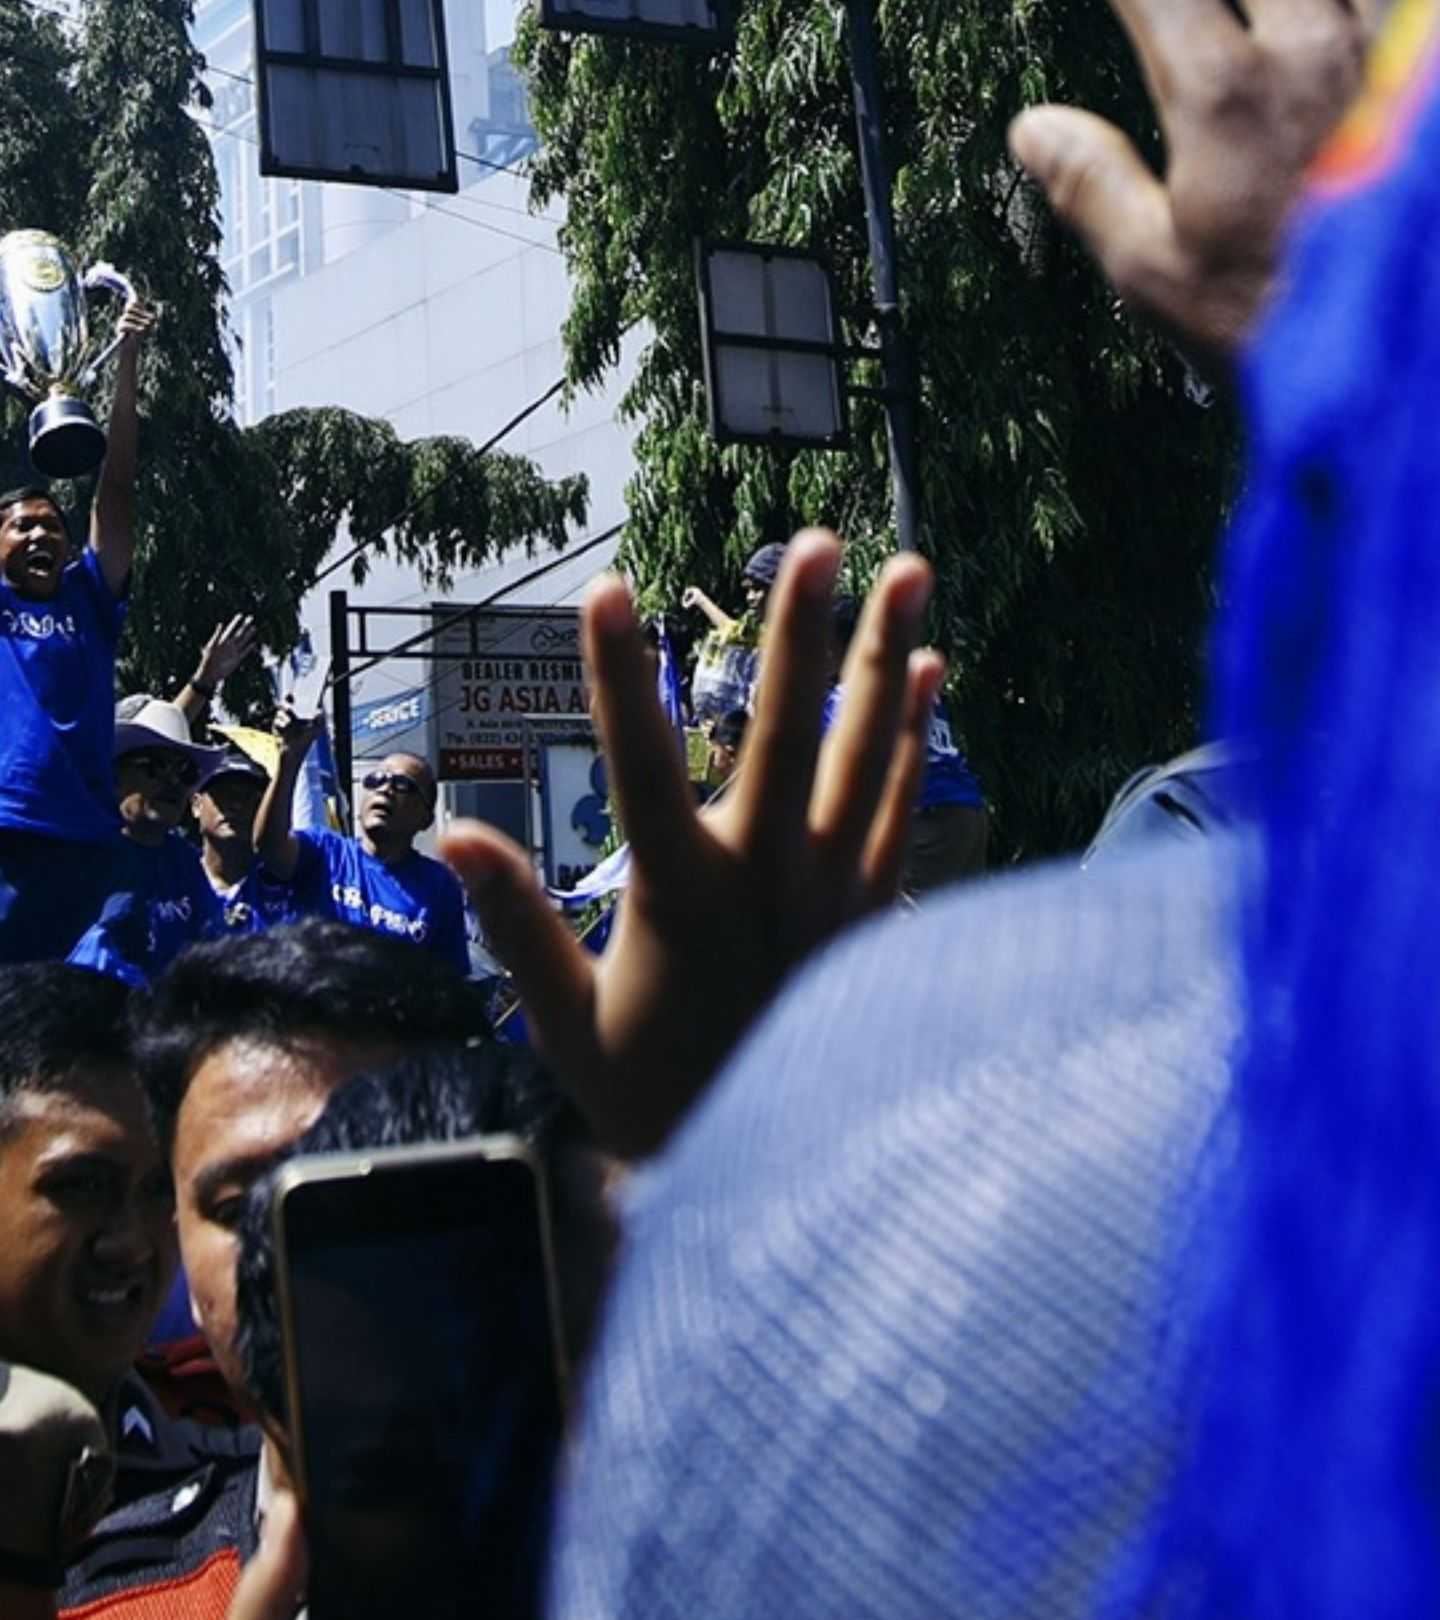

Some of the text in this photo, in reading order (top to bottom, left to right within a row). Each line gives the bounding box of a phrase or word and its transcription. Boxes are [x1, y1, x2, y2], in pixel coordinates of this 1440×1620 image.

[462, 662, 523, 680] DEALER
[459, 686, 491, 712] JG
[499, 686, 560, 712] ASIA
[460, 753, 505, 769] SALES
